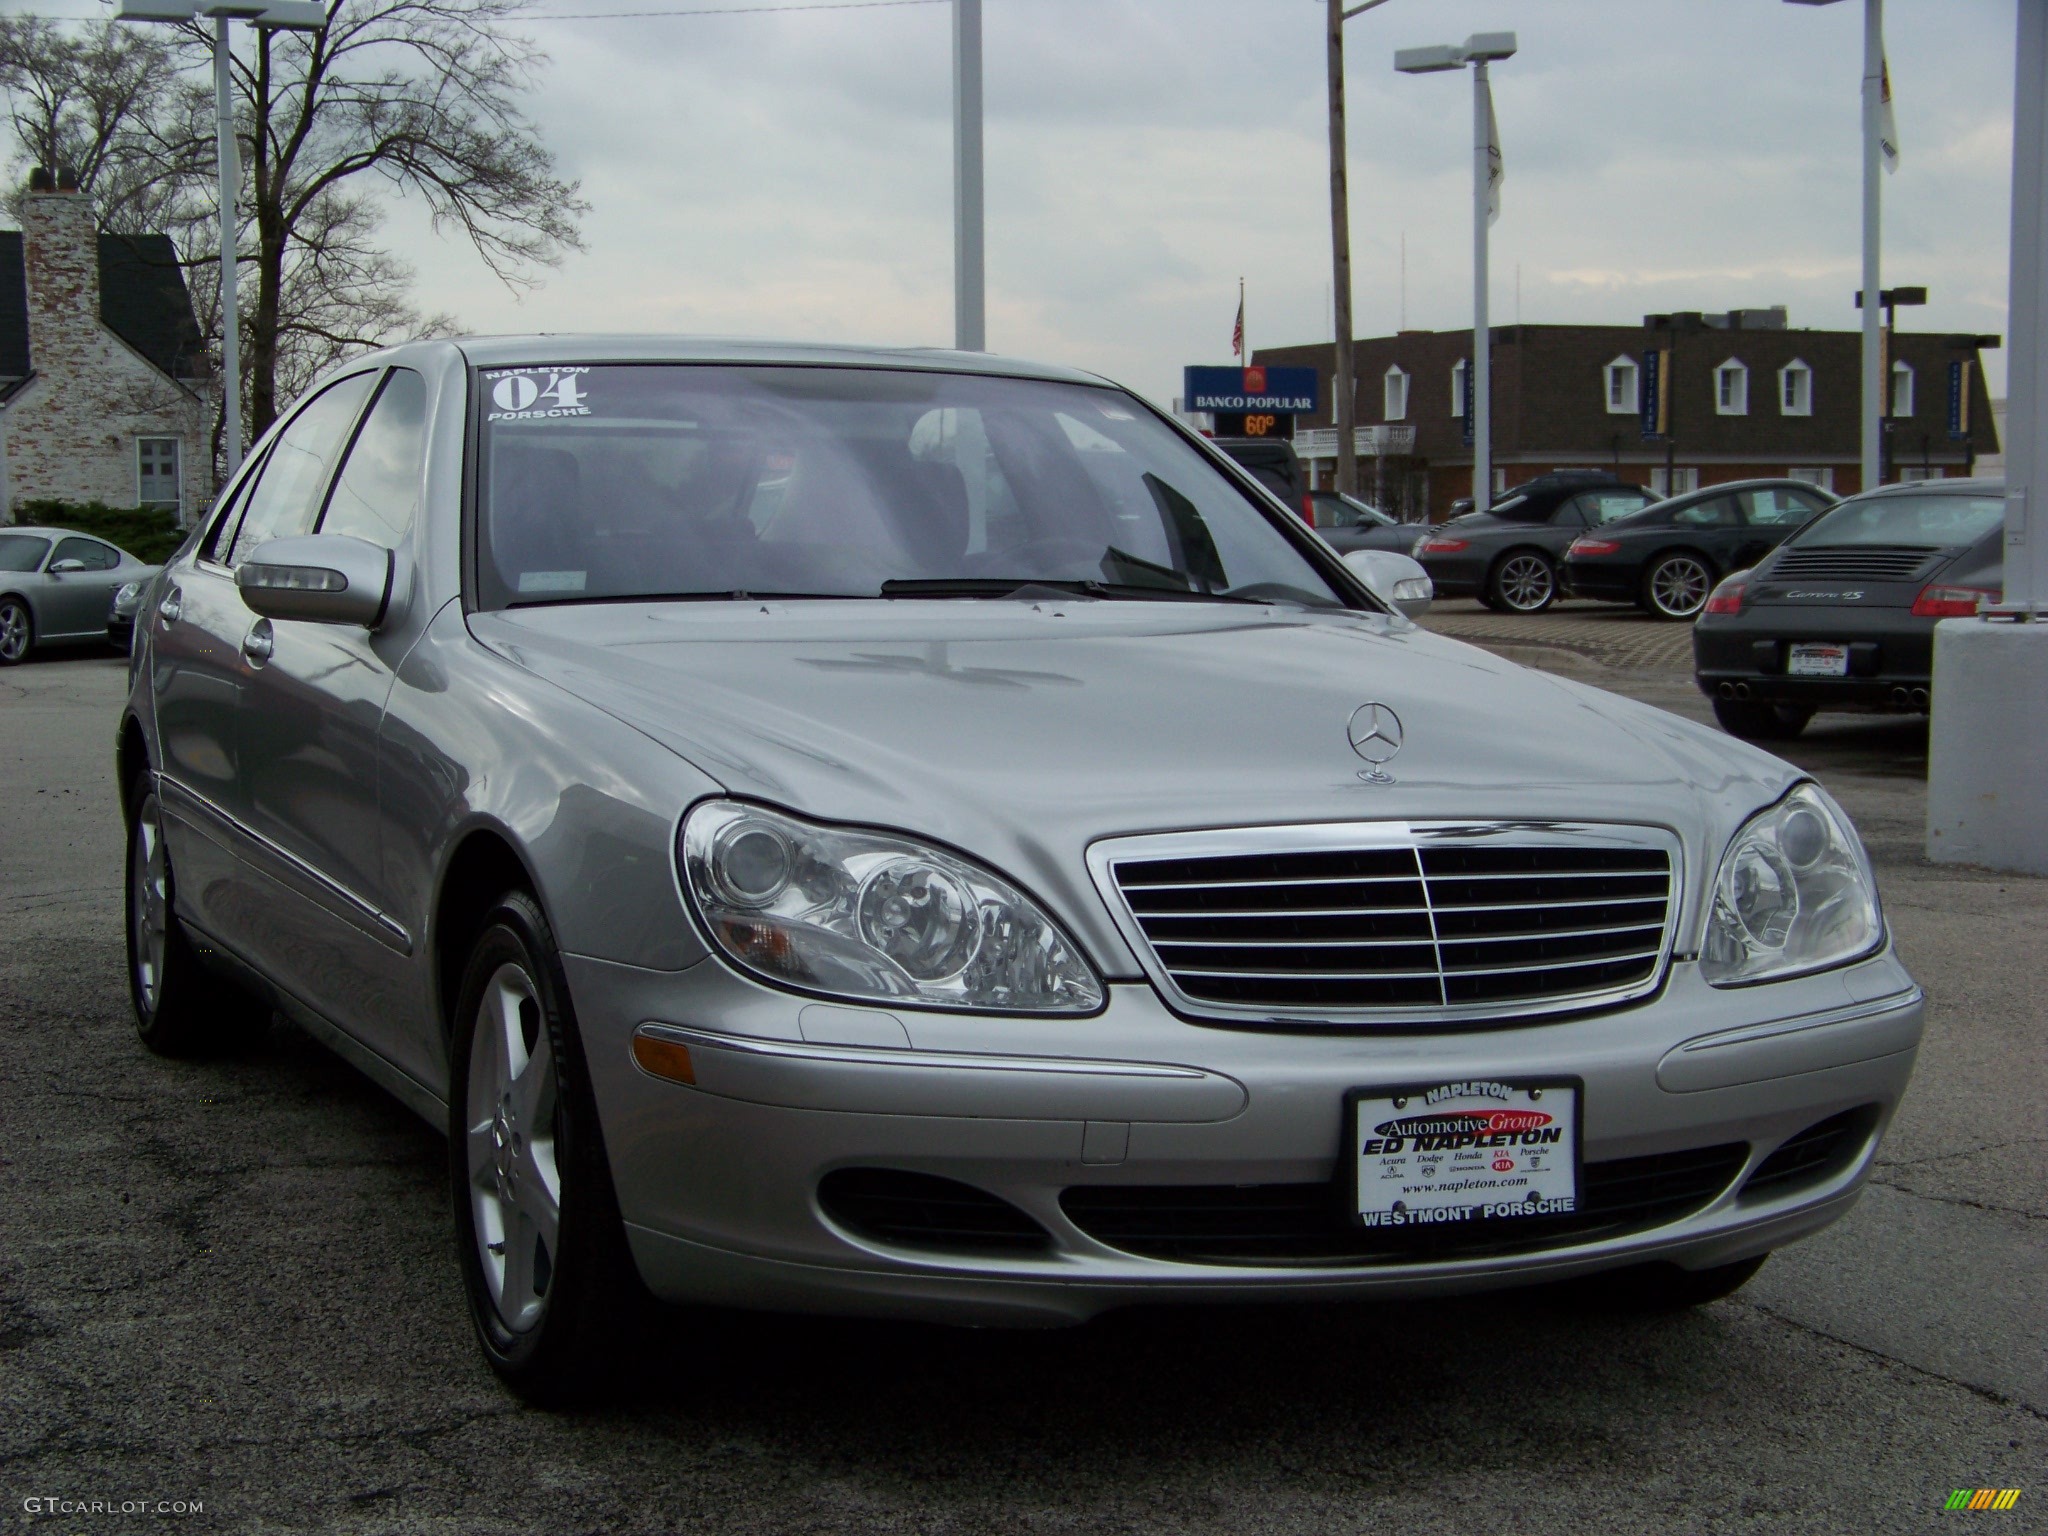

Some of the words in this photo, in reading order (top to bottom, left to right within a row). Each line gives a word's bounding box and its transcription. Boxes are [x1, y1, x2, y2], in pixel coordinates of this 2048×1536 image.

[485, 366, 590, 380] NAPLETON
[493, 373, 588, 411] 04
[1196, 396, 1244, 408] BANCO
[1247, 397, 1312, 409] POPULAR
[488, 407, 591, 421] PORSCHE
[1786, 590, 1839, 598] Carrera
[1842, 591, 1864, 599] 4S
[1426, 1081, 1513, 1105] NAPLETON
[1363, 1139, 1406, 1155] ED
[1413, 1128, 1562, 1152] NAPLETON
[1380, 1157, 1406, 1166] Acura
[1417, 1154, 1444, 1164] Dodge
[1454, 1151, 1482, 1161] Honda
[1493, 1150, 1510, 1158] KIA
[1520, 1147, 1549, 1156] Porsche
[1495, 1161, 1512, 1169] KIA
[1402, 1176, 1528, 1194] www.napleton.com
[1362, 1206, 1473, 1227] WESTMONT
[1483, 1197, 1575, 1218] PORSCHE
